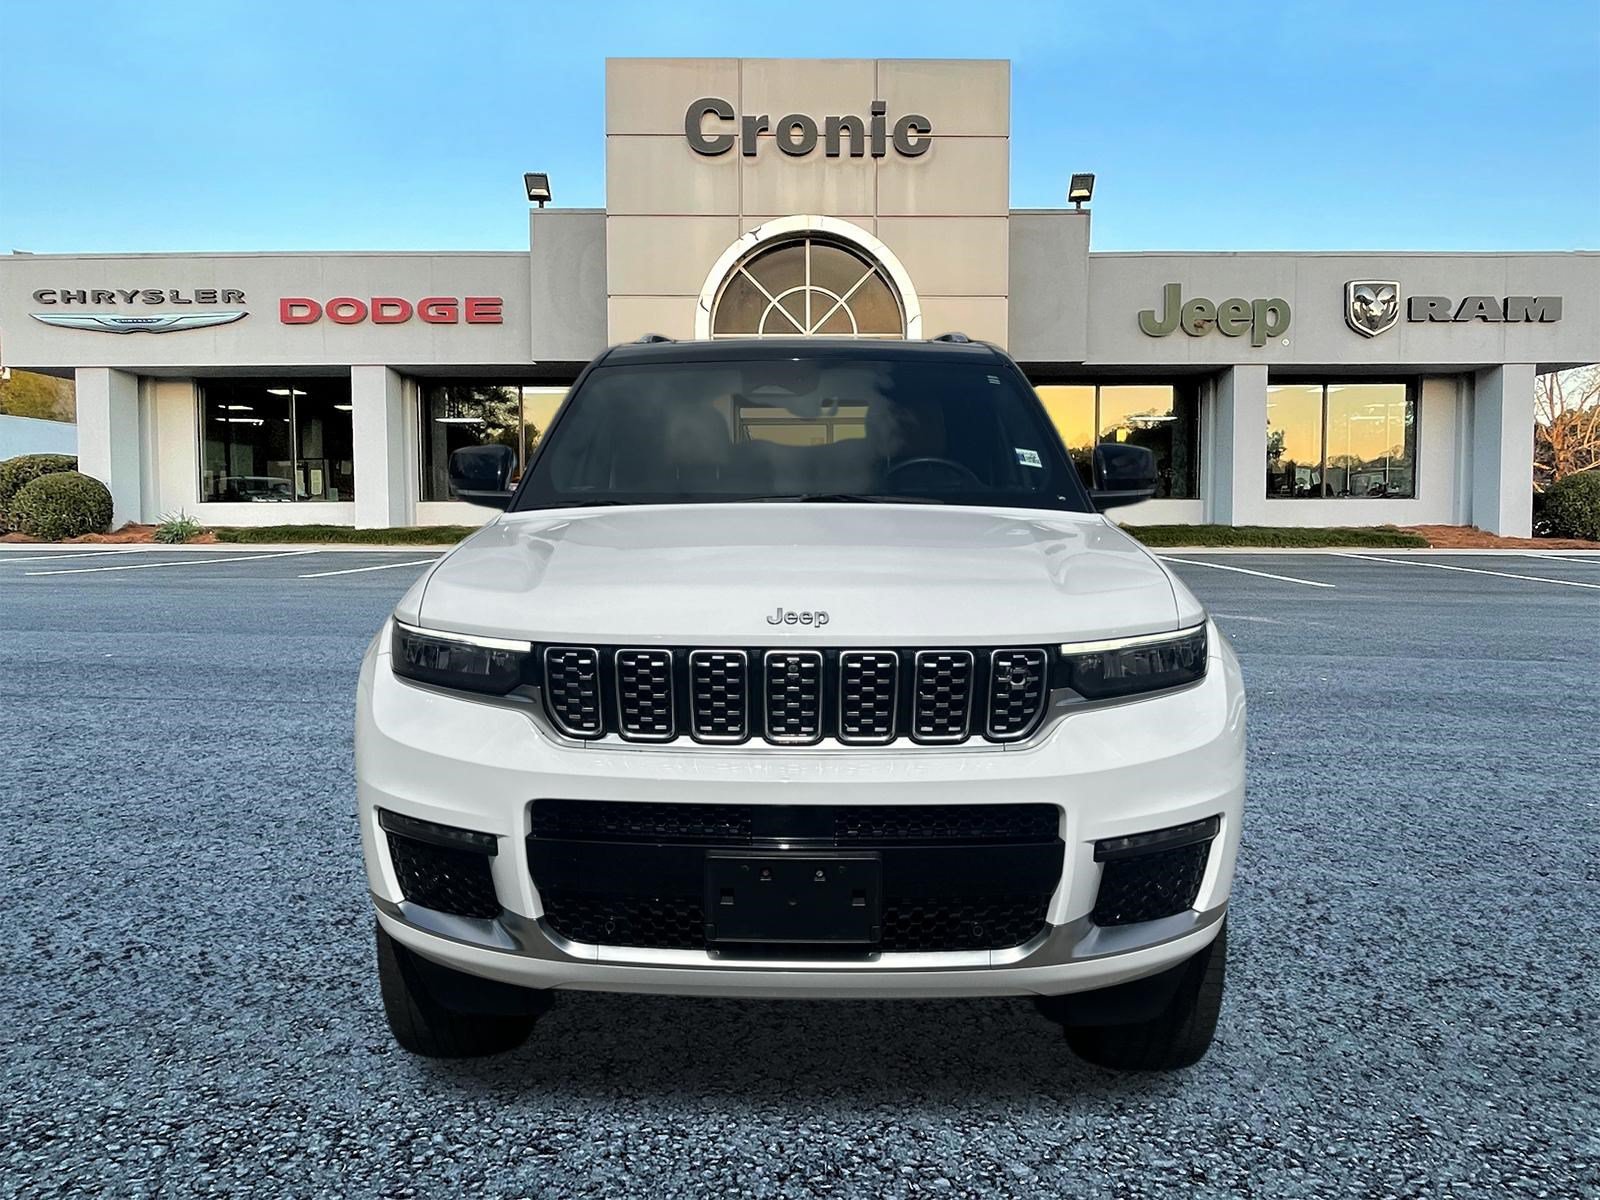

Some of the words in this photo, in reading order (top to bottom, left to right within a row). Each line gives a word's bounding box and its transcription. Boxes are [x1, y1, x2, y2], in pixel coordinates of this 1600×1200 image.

[684, 97, 932, 157] Cronic
[32, 289, 246, 304] CHRYSLER
[1407, 296, 1563, 322] RAM
[280, 297, 503, 324] DODGE
[1138, 283, 1291, 346] Jeep
[766, 607, 830, 628] Jeep
